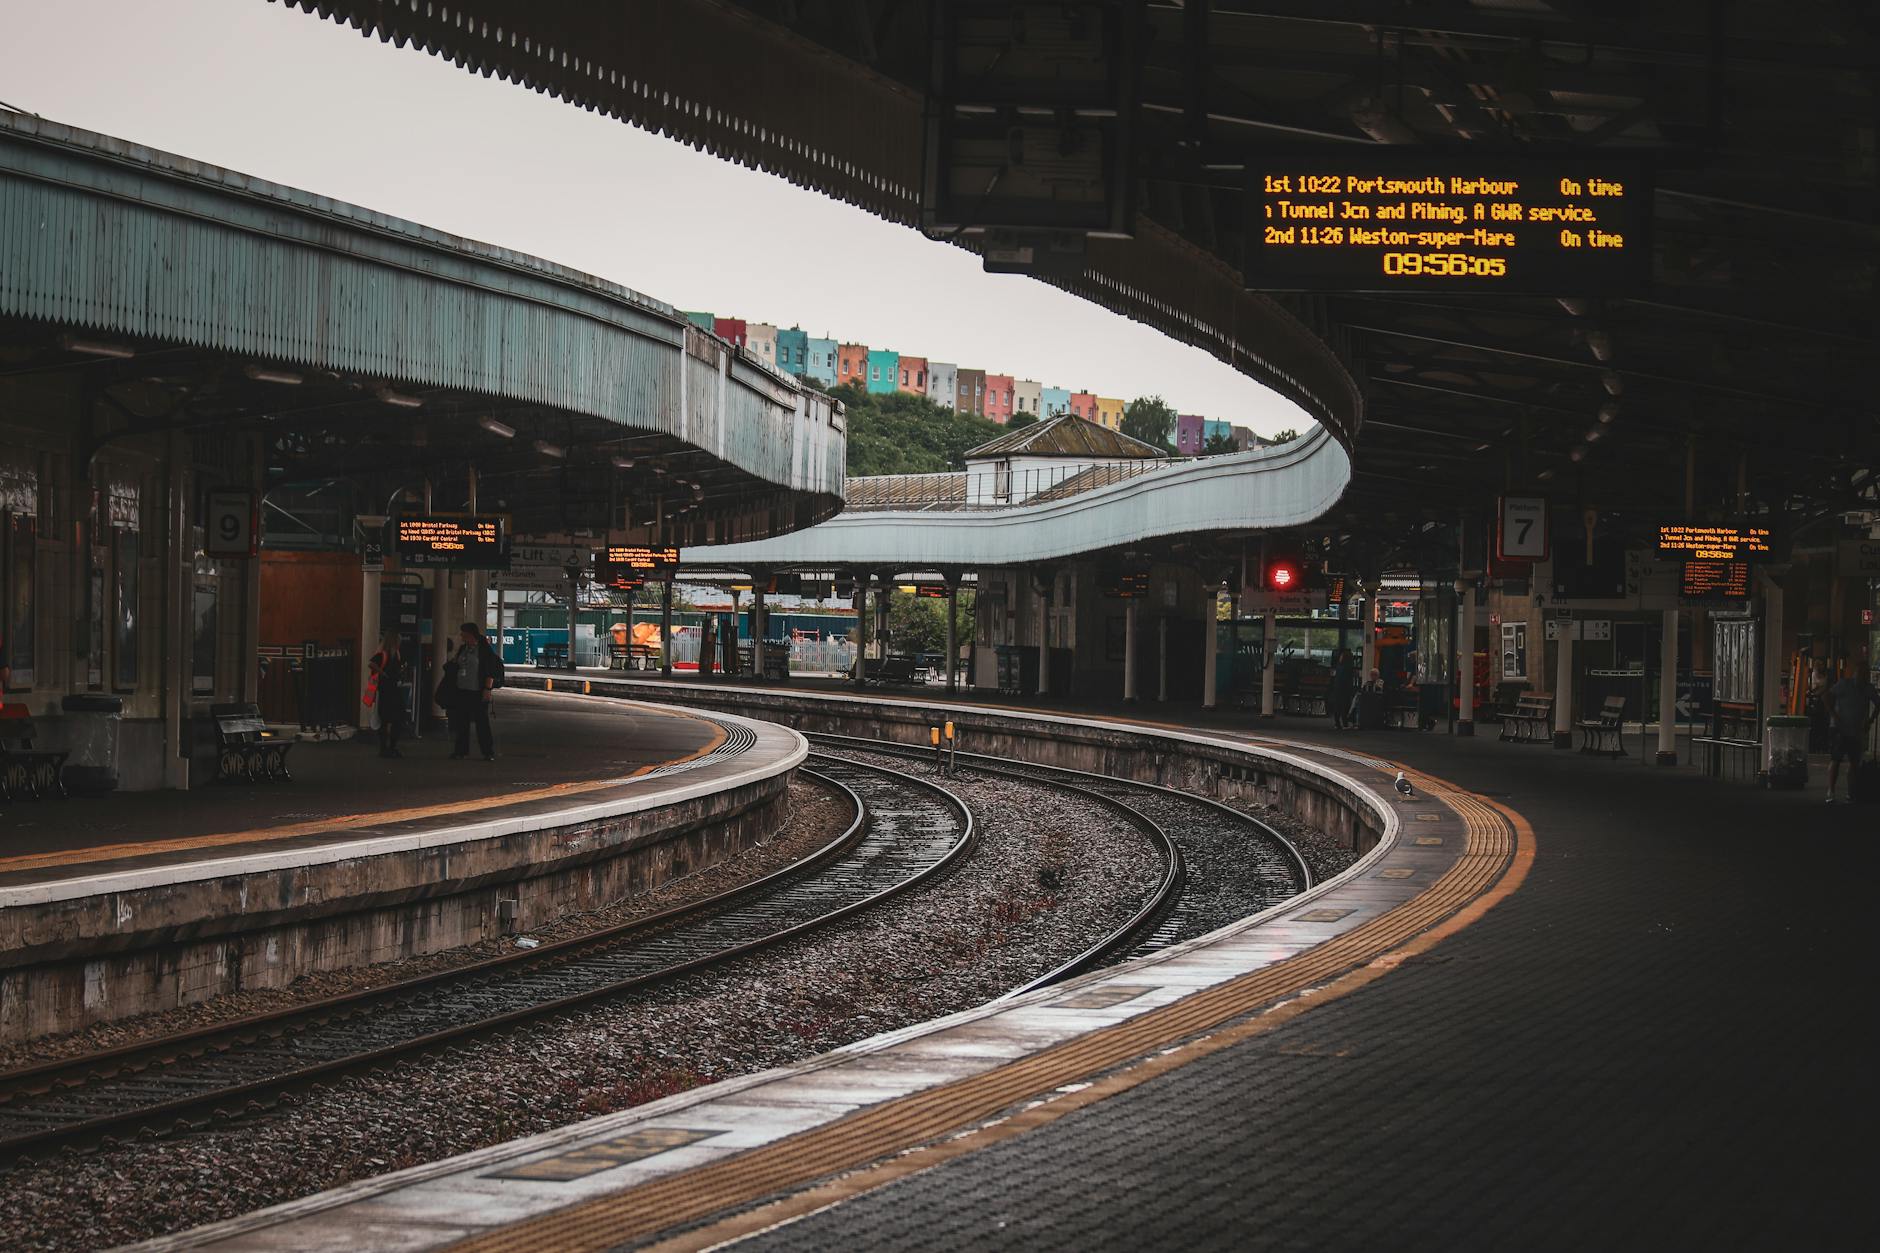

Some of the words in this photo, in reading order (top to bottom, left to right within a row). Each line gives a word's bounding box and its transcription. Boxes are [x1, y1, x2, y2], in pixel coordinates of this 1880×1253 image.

[1265, 176, 1292, 192] 1st
[1299, 176, 1341, 193] 10:22
[1347, 176, 1445, 194] Portsmouth
[1451, 177, 1518, 194] Harbour
[1561, 179, 1581, 195] On
[1587, 179, 1622, 196] time
[1278, 201, 1334, 218] Tunnel
[1340, 202, 1369, 219] Jcn
[1376, 203, 1405, 219] and
[1412, 203, 1467, 224] Pilning.
[1474, 203, 1484, 220] A
[1491, 203, 1522, 220] GWR
[1529, 204, 1596, 221] service.
[1265, 227, 1294, 244] 2nd
[1301, 227, 1343, 244] 11:26
[1350, 227, 1515, 249] Weston-super-Mare
[1561, 230, 1581, 247] On
[1588, 230, 1622, 247] time
[1384, 253, 1505, 276] 09:56:05
[219, 513, 241, 542] 9
[1514, 518, 1534, 545] 7
[523, 549, 543, 561] Lift
